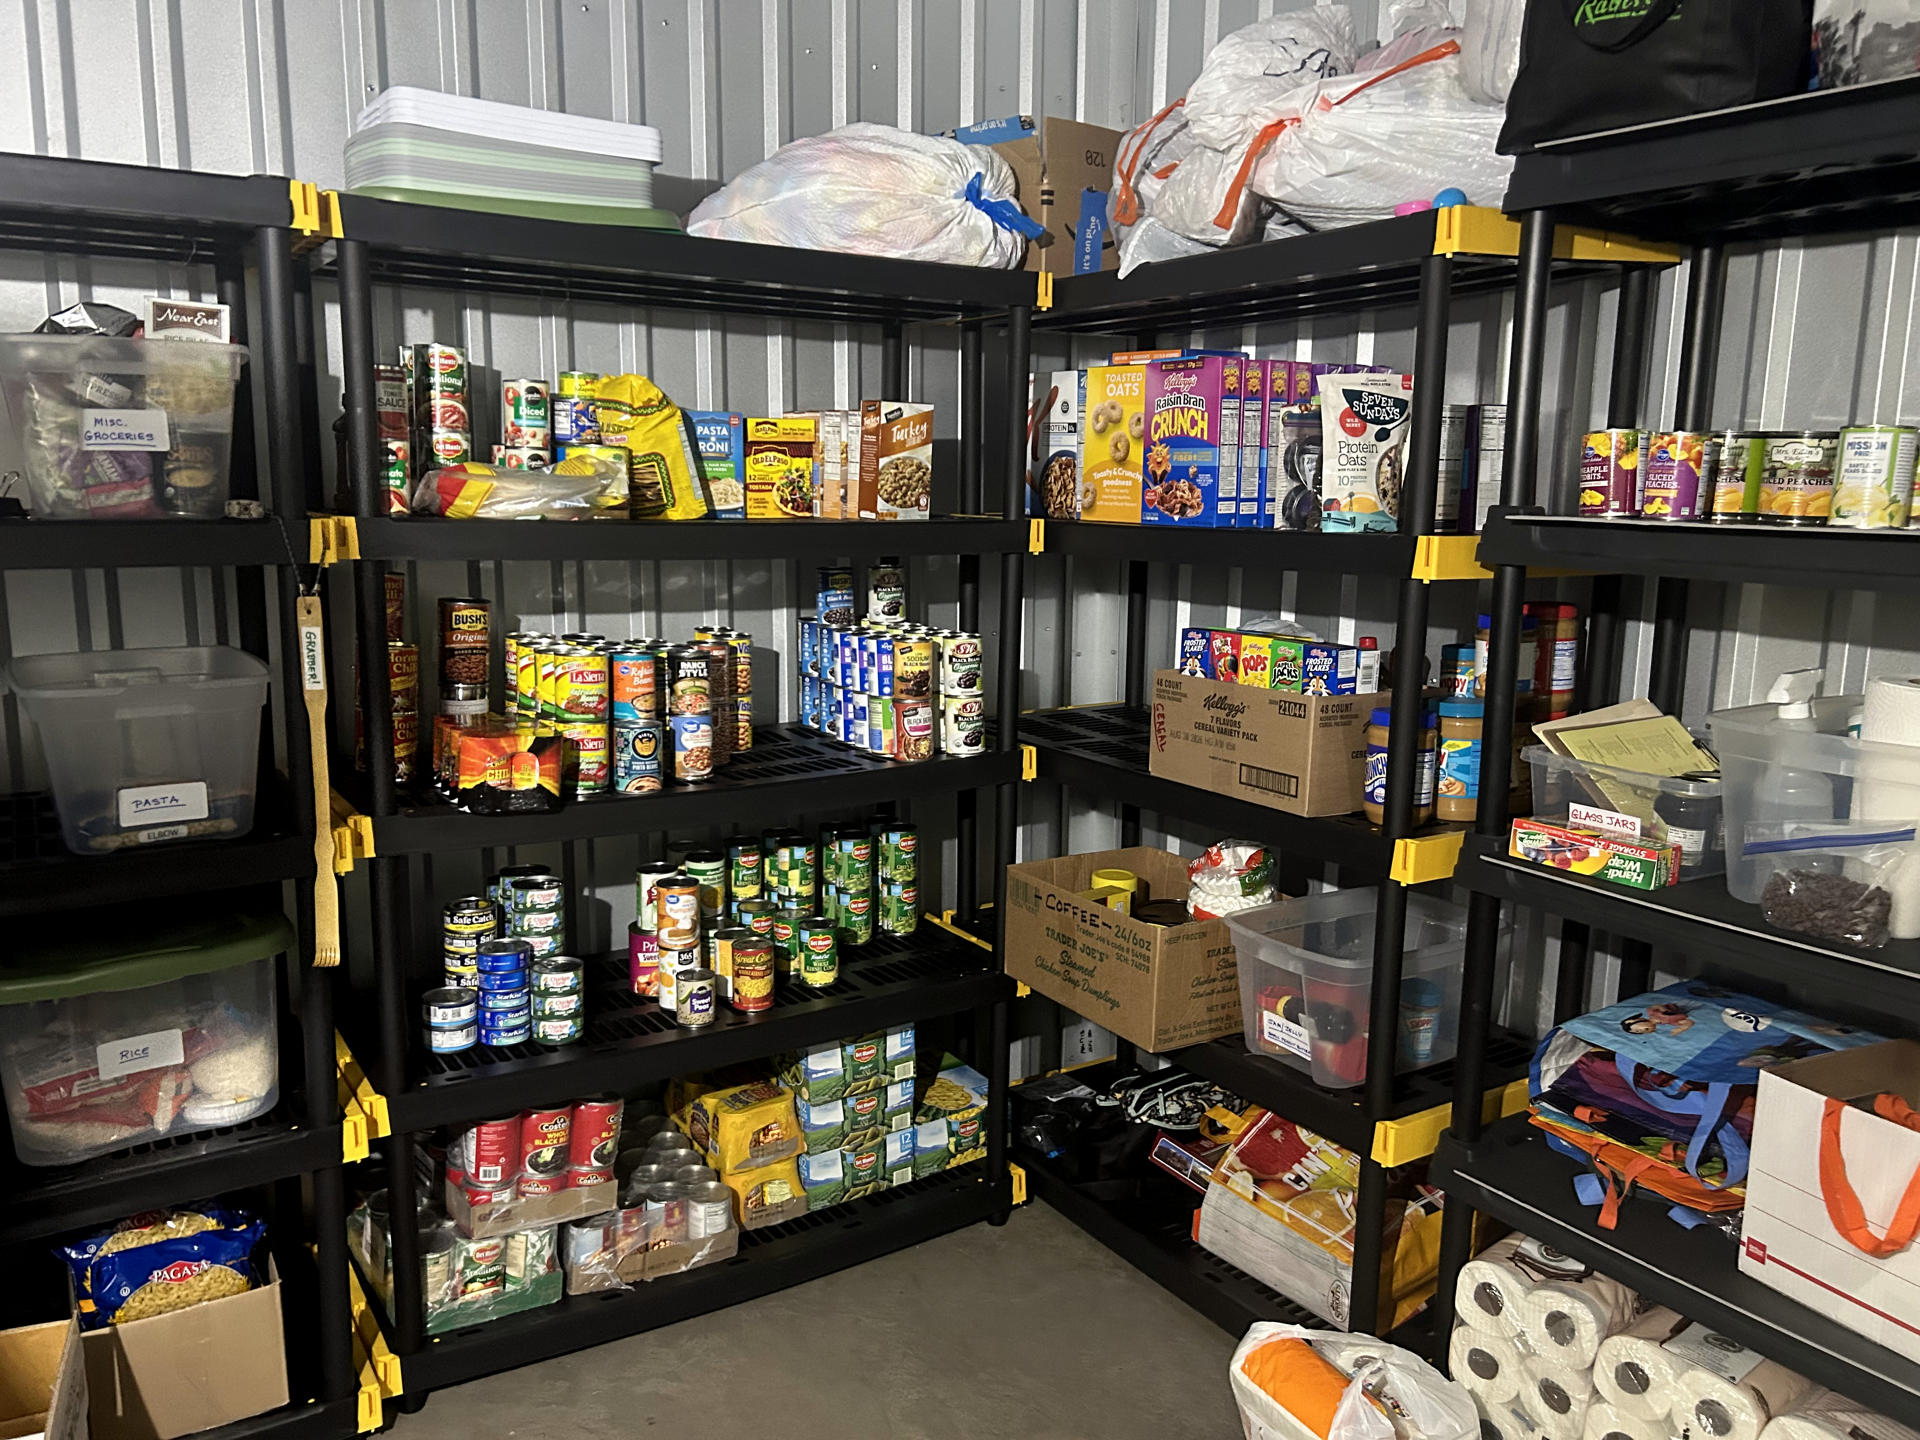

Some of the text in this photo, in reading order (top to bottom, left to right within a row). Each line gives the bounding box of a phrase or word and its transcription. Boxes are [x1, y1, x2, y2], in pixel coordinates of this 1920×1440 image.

[156, 307, 219, 327] Near East
[1105, 373, 1143, 384] TOASTED
[1164, 371, 1198, 392] Kellogg's
[1106, 382, 1140, 397] OATS
[377, 397, 407, 408] SAUCE
[1155, 392, 1206, 411] Raisin Bran
[1361, 391, 1395, 408] SEVEN
[519, 406, 545, 417] Diced
[1352, 400, 1401, 421] SUNDAYS
[94, 417, 128, 427] MISC.
[1150, 407, 1209, 442] CRUNCH
[84, 430, 155, 442] GROCERIES
[696, 425, 729, 436] PASTA
[891, 420, 928, 444] Turkey
[699, 441, 729, 452] RONI
[1337, 440, 1379, 454] Protein
[752, 455, 789, 466] OLD EL PASO
[1337, 453, 1367, 467] Oats
[749, 474, 757, 482] 12
[1092, 468, 1113, 481] Toasty
[1117, 467, 1143, 482] Crunchy
[1337, 475, 1350, 486] 10
[1648, 473, 1675, 481] SLICED
[1103, 479, 1133, 488] goodness
[1645, 480, 1680, 489] PEACHES
[1786, 477, 1834, 486] PEACHES
[826, 594, 842, 603] Black
[453, 612, 488, 626] BUSH'S
[1182, 638, 1207, 648] FROSTED
[1183, 645, 1204, 654] FLAKES
[906, 655, 930, 663] SODIUM
[951, 656, 967, 664] BLACK
[1241, 654, 1269, 674] POPS
[1305, 656, 1333, 666] FROSTED
[679, 661, 706, 670] RANCH
[1305, 663, 1332, 672] FLAKES
[572, 670, 605, 683] La Sierra
[678, 669, 708, 678] STYLE
[1271, 665, 1300, 688] JACKS
[1164, 679, 1182, 690] COUNT
[1203, 693, 1247, 718] Kellogg's
[1279, 701, 1306, 718] 21044
[1320, 702, 1354, 714] 48 COUNT
[957, 714, 973, 722] BLACK
[1210, 715, 1242, 729] 7 FLAVORS
[1154, 702, 1168, 753] CEREAL
[1193, 721, 1216, 734] CEREAL
[1216, 726, 1241, 740] VARIETY
[1241, 731, 1259, 743] PACK
[583, 738, 605, 750] Sierra
[132, 795, 179, 809] PASTA
[1571, 809, 1637, 832] GLASS JARS
[1608, 842, 1648, 858] STORAGE
[1607, 853, 1642, 872] Wrap
[1603, 867, 1645, 884] Handi-
[452, 914, 495, 924] Safe Catch
[1045, 926, 1105, 964] TRADER JOE'S
[679, 951, 693, 961] 365
[1060, 950, 1097, 979] Steamed
[1035, 955, 1121, 1011] Chicken Soup Dumplings
[495, 992, 522, 1001] StarKist
[691, 997, 711, 1005] Sweet
[693, 1003, 710, 1011] Peas
[500, 1028, 526, 1037] StarKist
[119, 1046, 149, 1062] RICE
[555, 1116, 564, 1124] La
[534, 1136, 558, 1146] BLACK
[901, 1133, 912, 1144] 12
[1282, 1138, 1342, 1192] CAN'T
[152, 1259, 211, 1283] PAGASA
